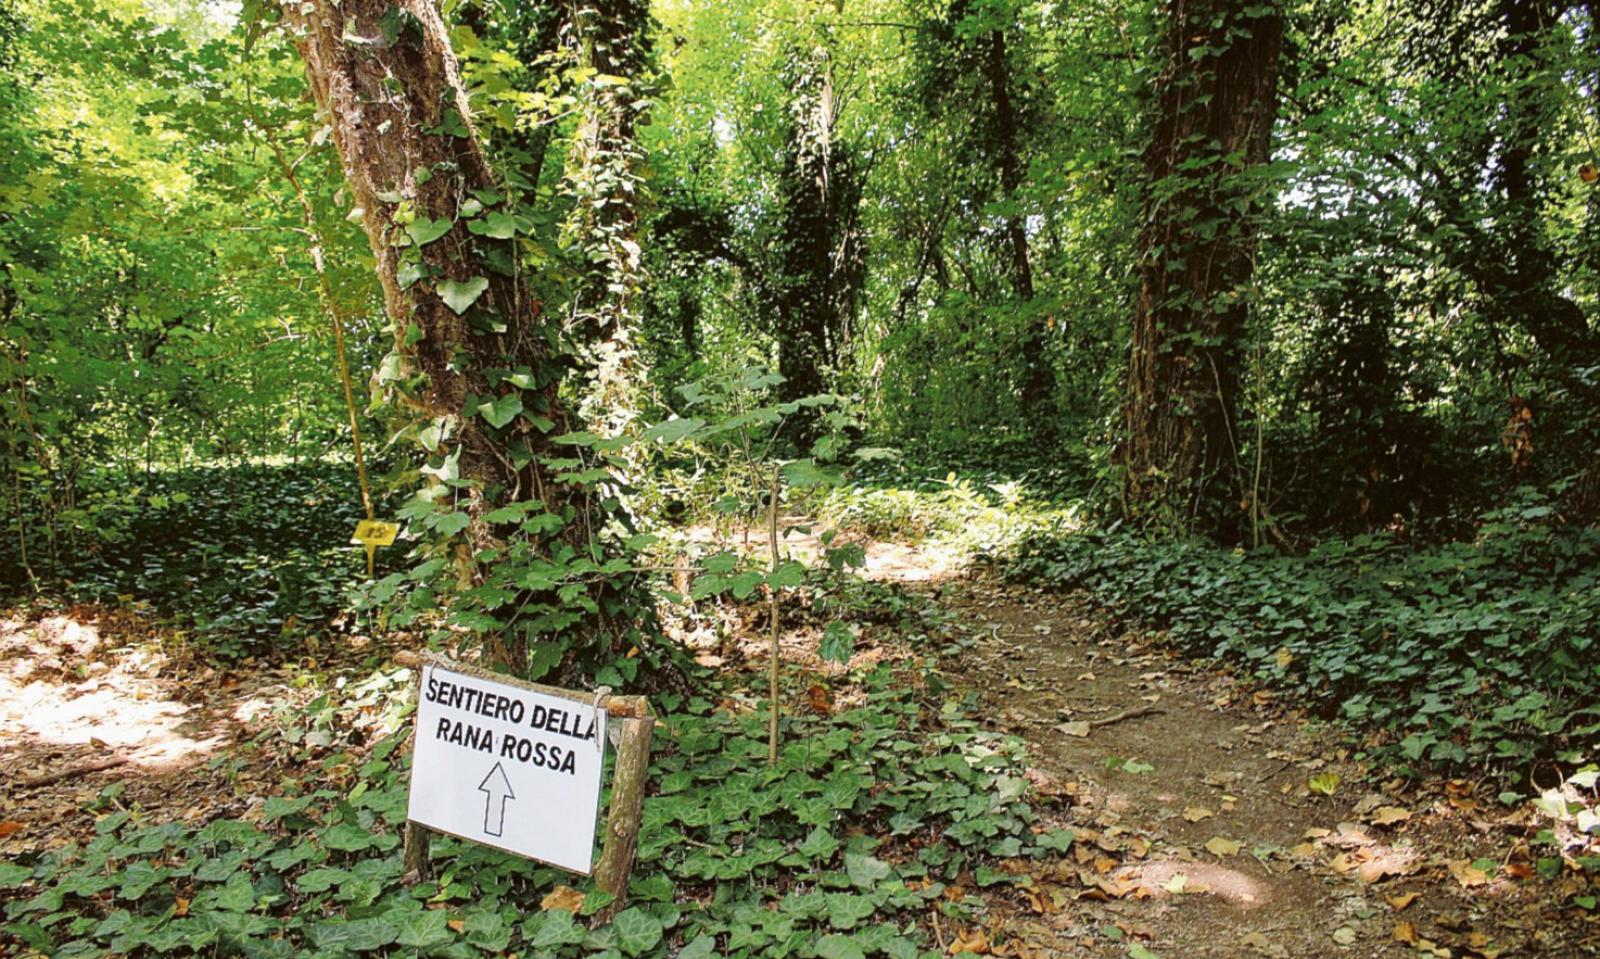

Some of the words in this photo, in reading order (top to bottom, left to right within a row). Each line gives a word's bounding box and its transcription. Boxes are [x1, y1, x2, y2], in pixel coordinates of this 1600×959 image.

[425, 678, 525, 724] SENTIERO
[531, 704, 596, 741] DELLA
[436, 717, 493, 754] RANA
[500, 734, 576, 775] ROSSA
